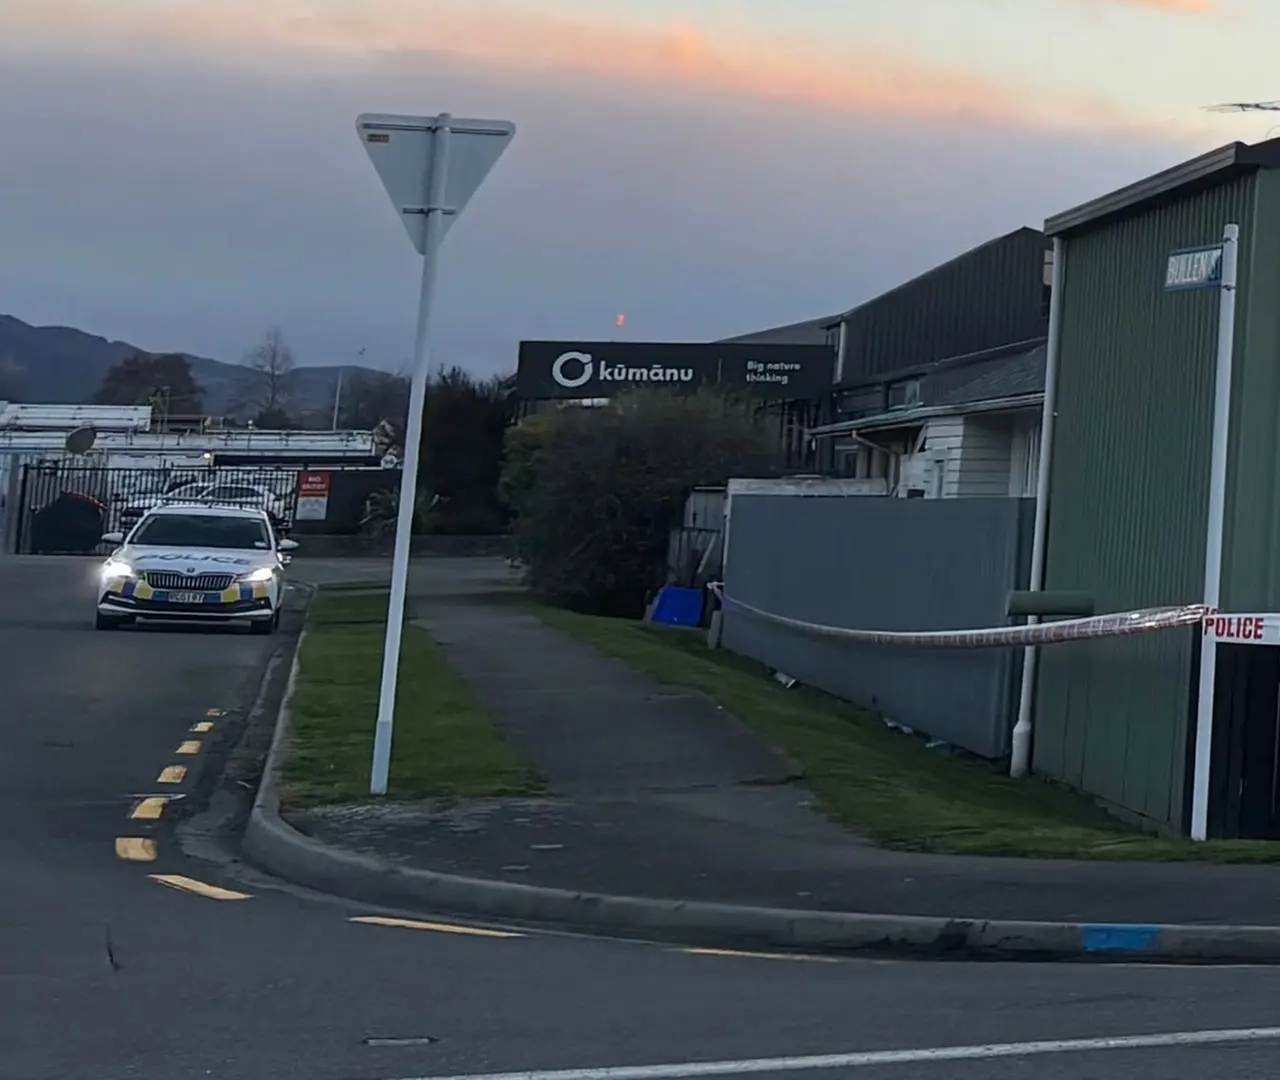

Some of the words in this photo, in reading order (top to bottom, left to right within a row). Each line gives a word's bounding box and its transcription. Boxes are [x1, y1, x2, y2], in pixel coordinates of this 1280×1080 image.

[599, 360, 693, 382] kūmānu
[747, 361, 763, 372] Big
[766, 362, 801, 371] nature
[746, 372, 788, 385] thinking
[136, 552, 250, 565] POLICE
[1204, 617, 1264, 640] POLICE
